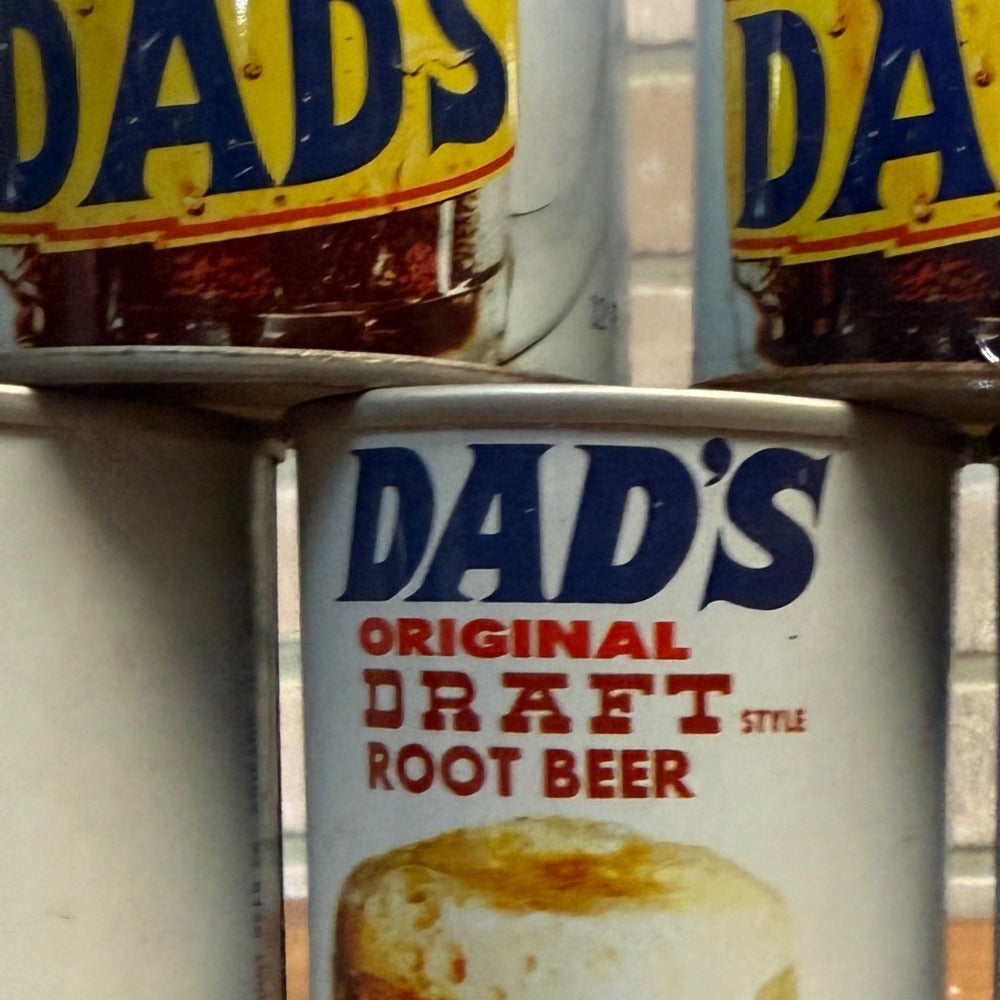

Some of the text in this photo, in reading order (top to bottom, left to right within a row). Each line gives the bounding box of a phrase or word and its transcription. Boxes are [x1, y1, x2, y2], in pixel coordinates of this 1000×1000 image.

[0, 0, 508, 212] DADS
[335, 437, 830, 611] DAD'S
[358, 617, 691, 660] ORIGINAL
[363, 669, 808, 735] DRAFT STYLE
[367, 742, 696, 800] ROOT BEER
